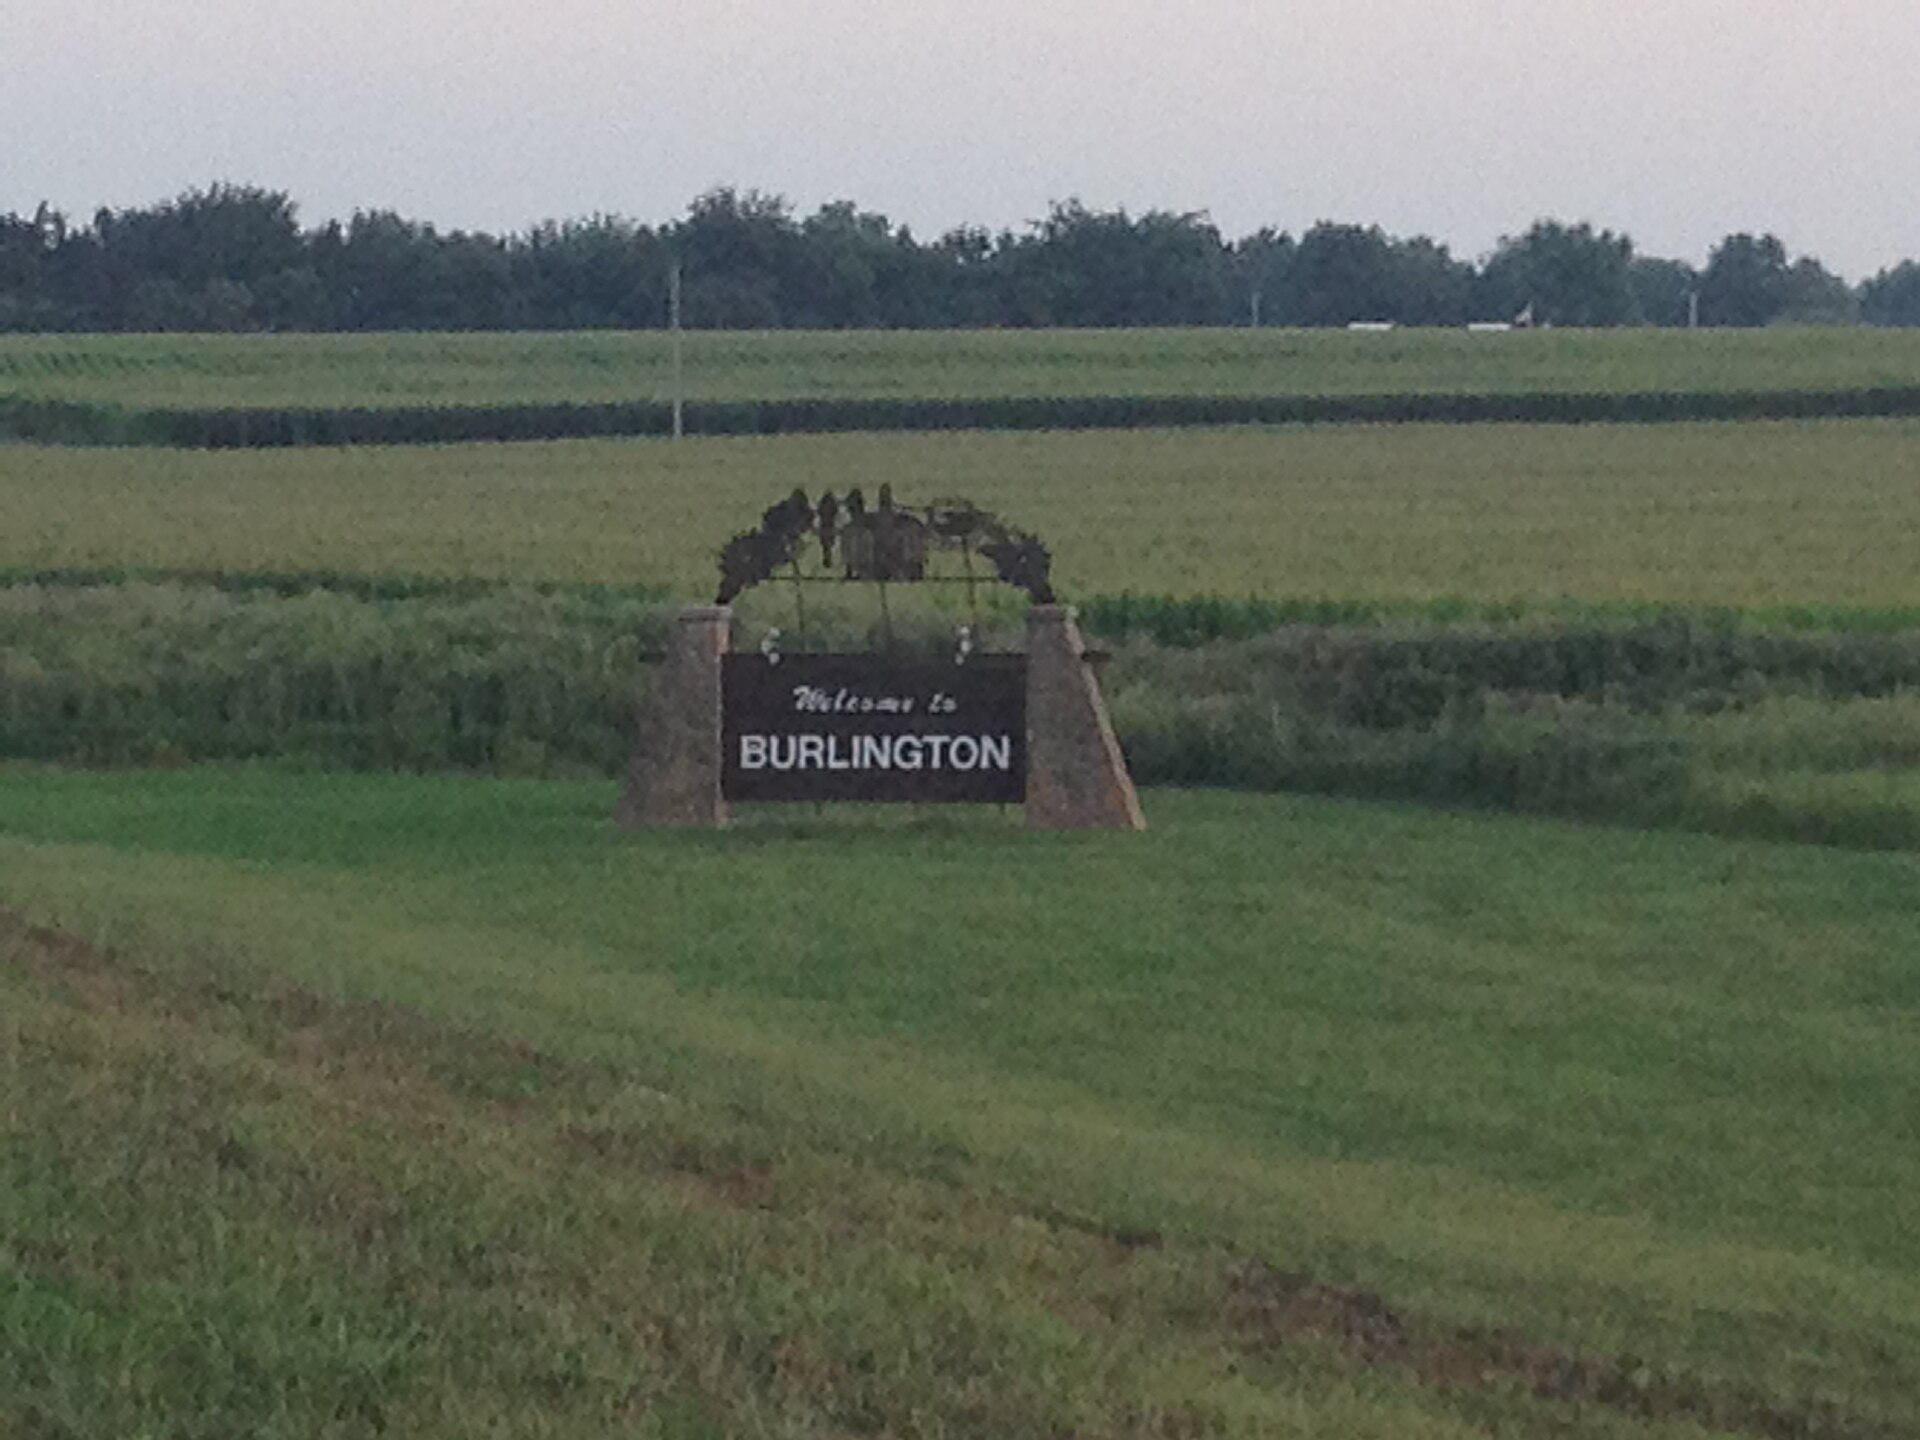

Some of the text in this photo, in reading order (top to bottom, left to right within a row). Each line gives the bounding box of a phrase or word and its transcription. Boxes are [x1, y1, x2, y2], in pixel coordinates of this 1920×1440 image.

[793, 685, 957, 713] Welcome to
[740, 734, 1010, 769] BURLINGTON
